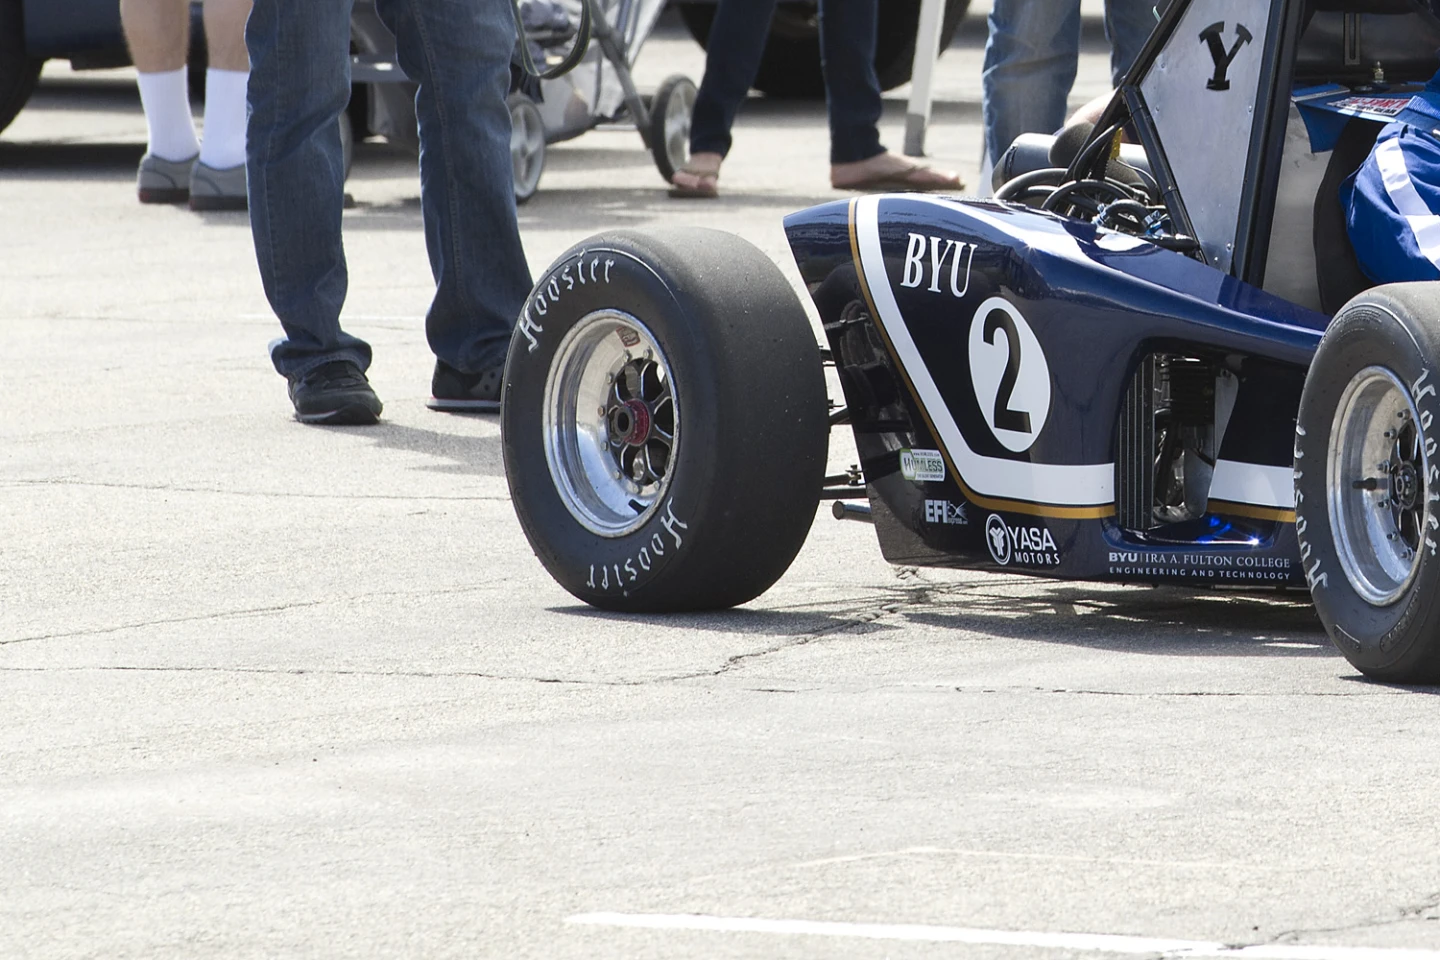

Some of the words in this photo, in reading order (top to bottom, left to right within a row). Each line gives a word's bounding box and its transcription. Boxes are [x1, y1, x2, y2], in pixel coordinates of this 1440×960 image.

[1198, 21, 1253, 91] Y
[900, 232, 978, 298] BYU
[519, 250, 615, 353] Hoosier
[983, 308, 1033, 434] 2
[1007, 526, 1058, 551] YASA
[1014, 551, 1060, 565] MOTORS
[1108, 552, 1138, 562] BYU
[1145, 553, 1166, 563] IRA
[1169, 554, 1181, 565] A.
[1183, 555, 1233, 566] FULTON
[1236, 556, 1290, 568] COLLEGE
[1109, 566, 1186, 576] ENGINEERING
[1191, 569, 1214, 577] AND
[1219, 570, 1290, 580] TECHNOLOGY
